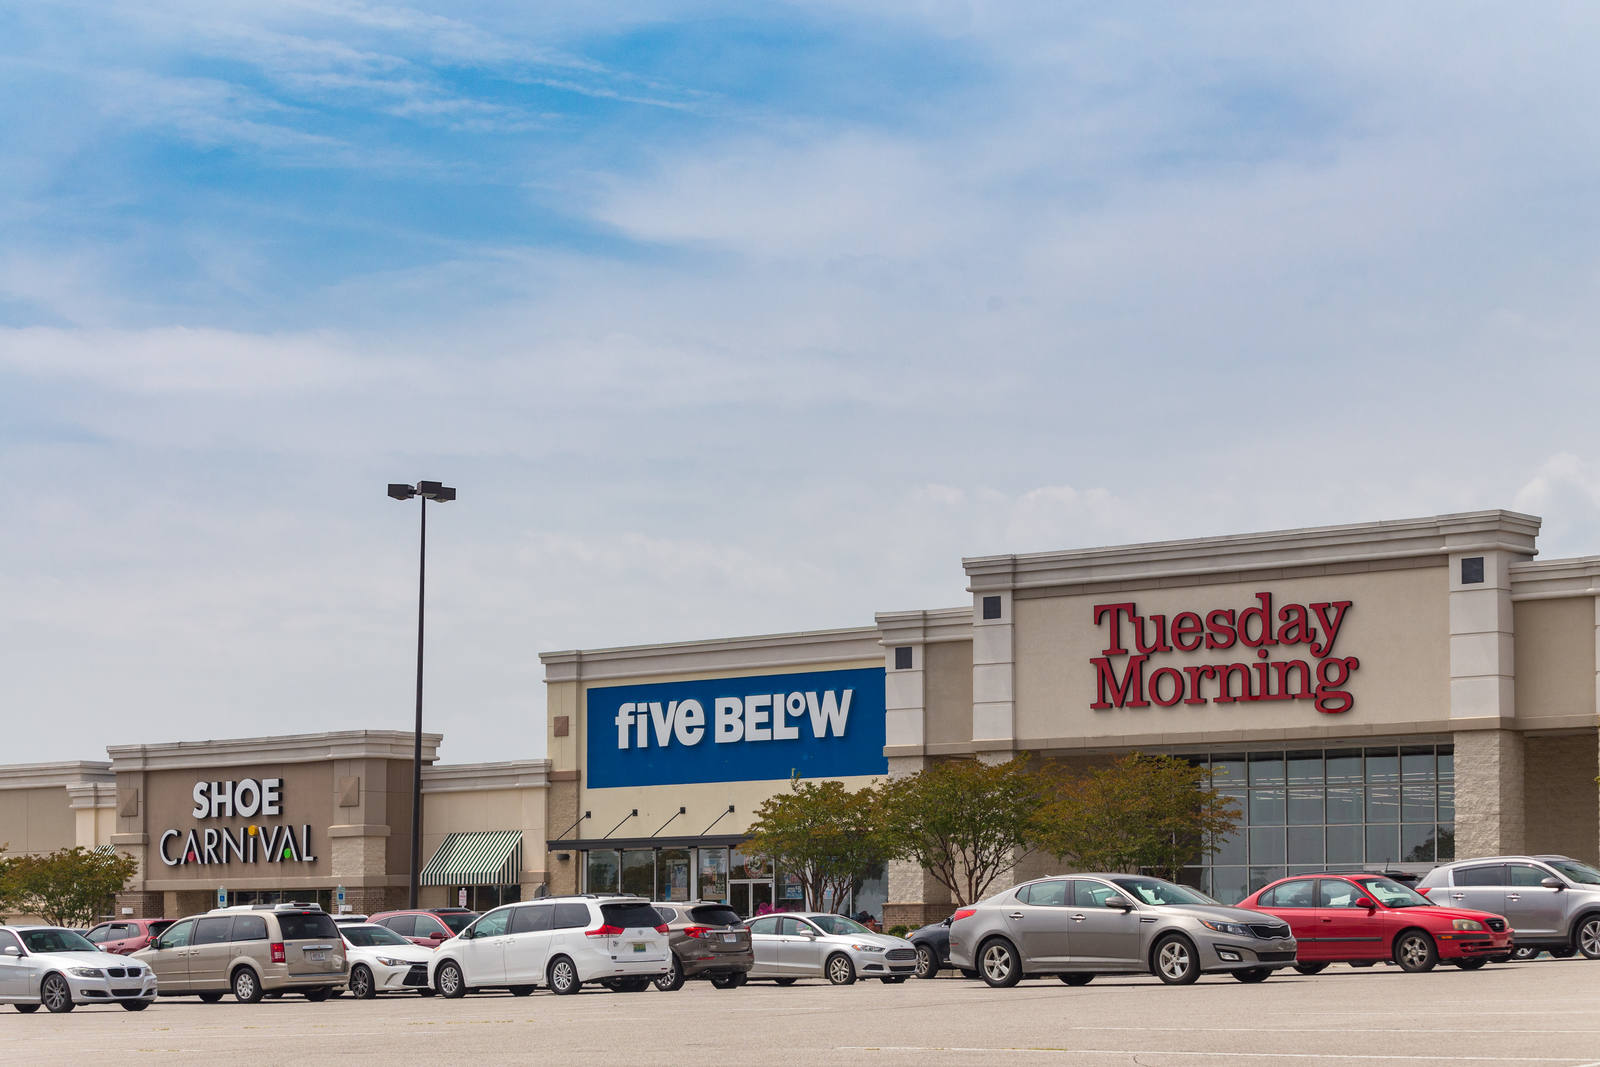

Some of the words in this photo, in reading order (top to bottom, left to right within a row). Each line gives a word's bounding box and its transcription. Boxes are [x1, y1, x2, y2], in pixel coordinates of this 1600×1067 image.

[1093, 591, 1353, 658] Tuesday
[1089, 648, 1360, 714] Morning
[615, 698, 705, 749] five
[715, 689, 853, 743] BELOW
[192, 778, 283, 819] SHOE
